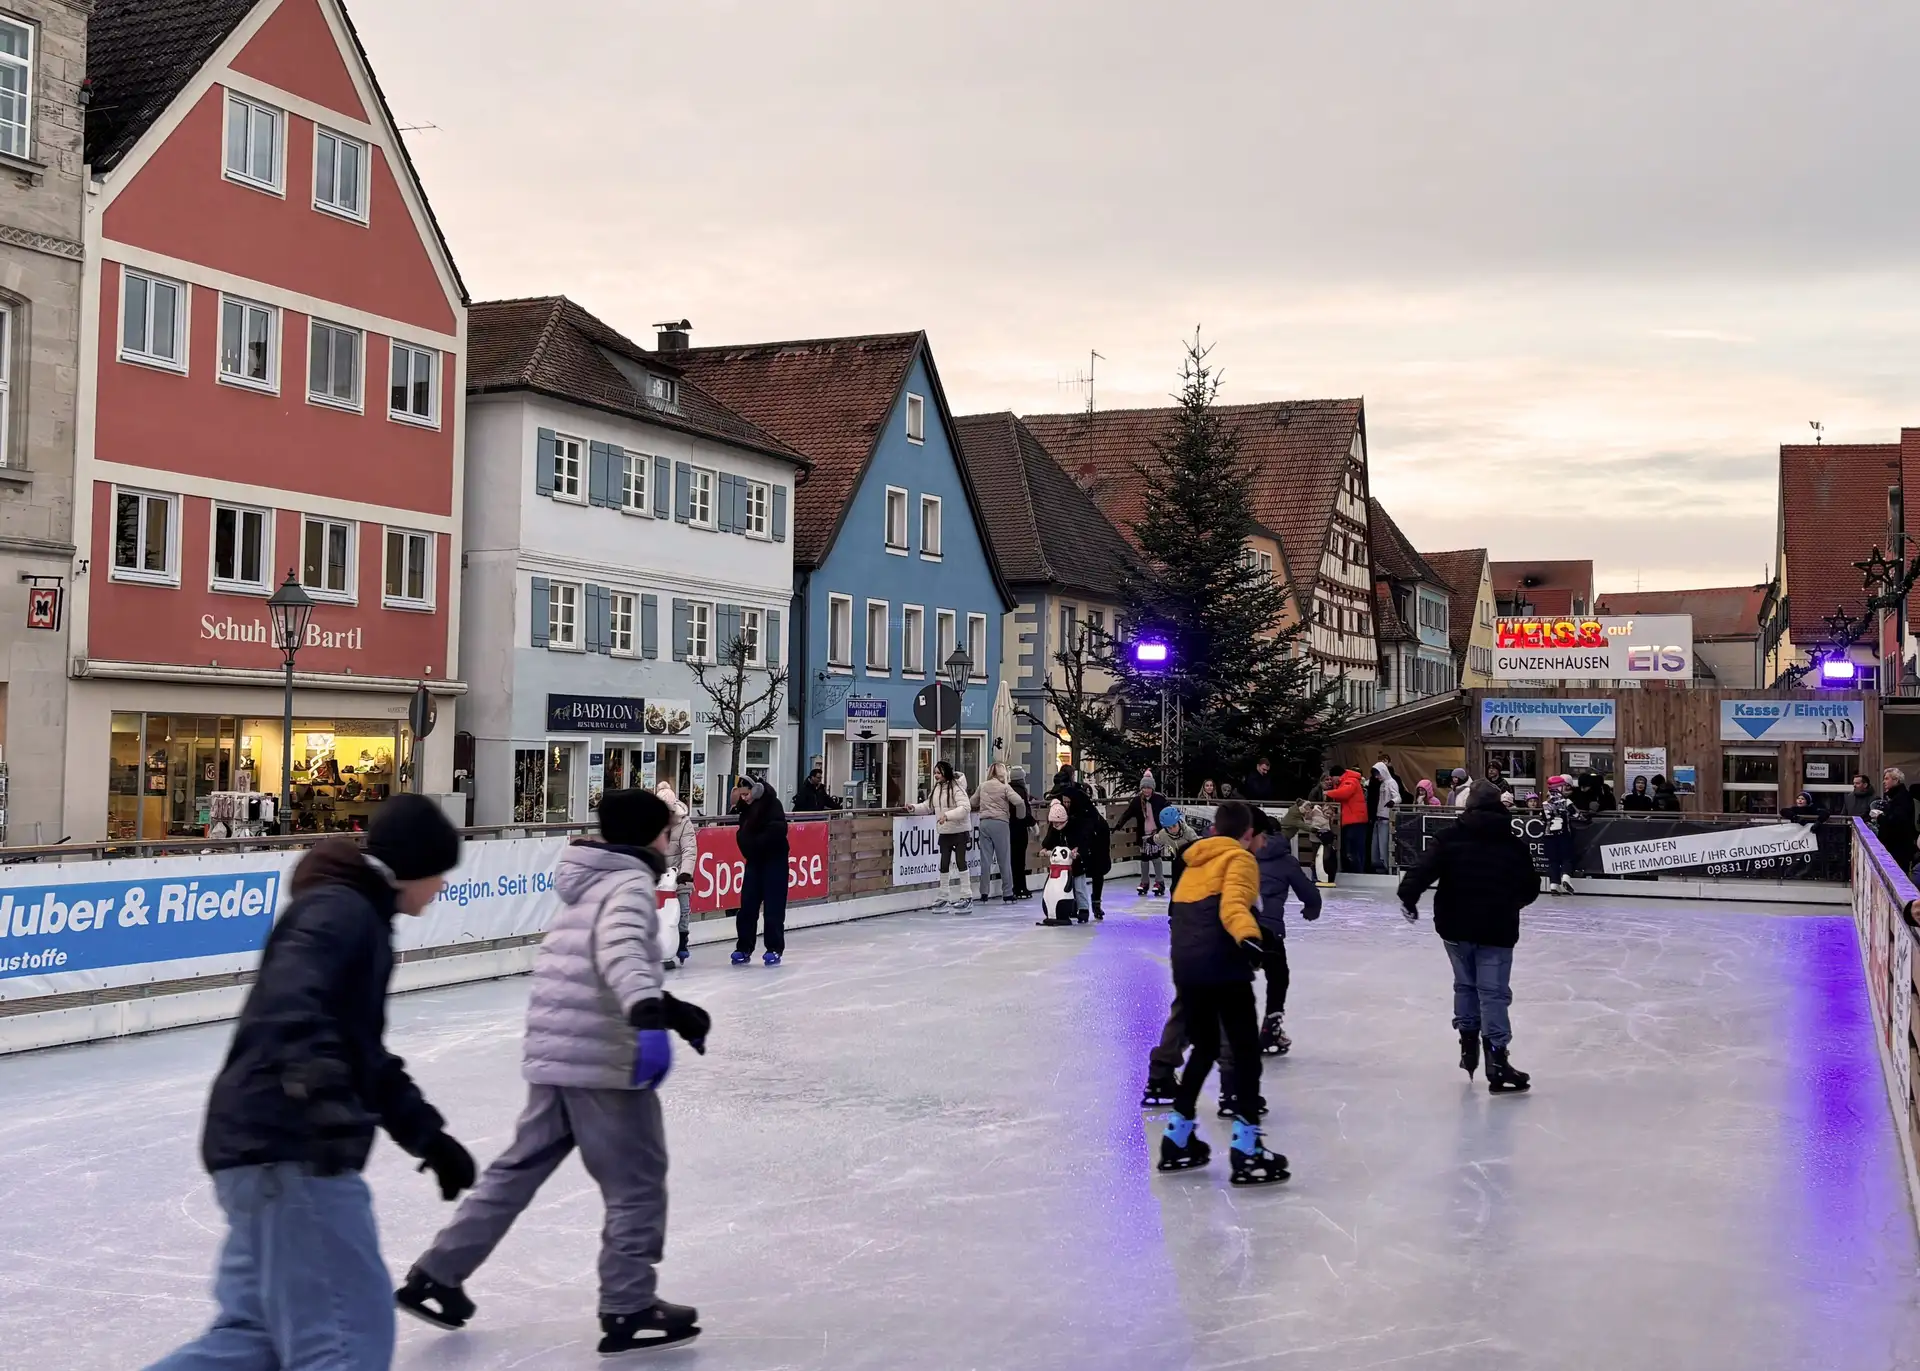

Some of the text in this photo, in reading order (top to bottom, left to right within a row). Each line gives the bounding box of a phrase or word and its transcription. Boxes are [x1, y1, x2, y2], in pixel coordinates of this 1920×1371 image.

[35, 600, 49, 616] M
[201, 614, 363, 650] Schuh Bartl
[1498, 621, 1633, 648] HEISS auf
[1498, 655, 1609, 670] GUNZENHAUSEN
[1628, 645, 1685, 672] EIS
[572, 702, 632, 719] BABYLON
[854, 709, 880, 717] AUTOMAT
[1484, 701, 1613, 715] Schlittschuhverleih
[1734, 703, 1849, 718] Kasse / Eintritt
[1609, 840, 1677, 858] WIR KAUFEN
[1611, 838, 1810, 872] IHRE IMMOBILIE / IHR GRUNDSTÜCK!
[900, 863, 937, 876] Datenschutz
[1707, 863, 1742, 875] 09831
[1745, 860, 1750, 872] /
[1754, 858, 1775, 870] 890
[1780, 857, 1792, 866] 79
[1804, 853, 1811, 864] 0
[438, 878, 495, 907] Region.
[498, 873, 528, 897] Seit
[118, 887, 150, 928] &
[158, 877, 276, 924] Riedel
